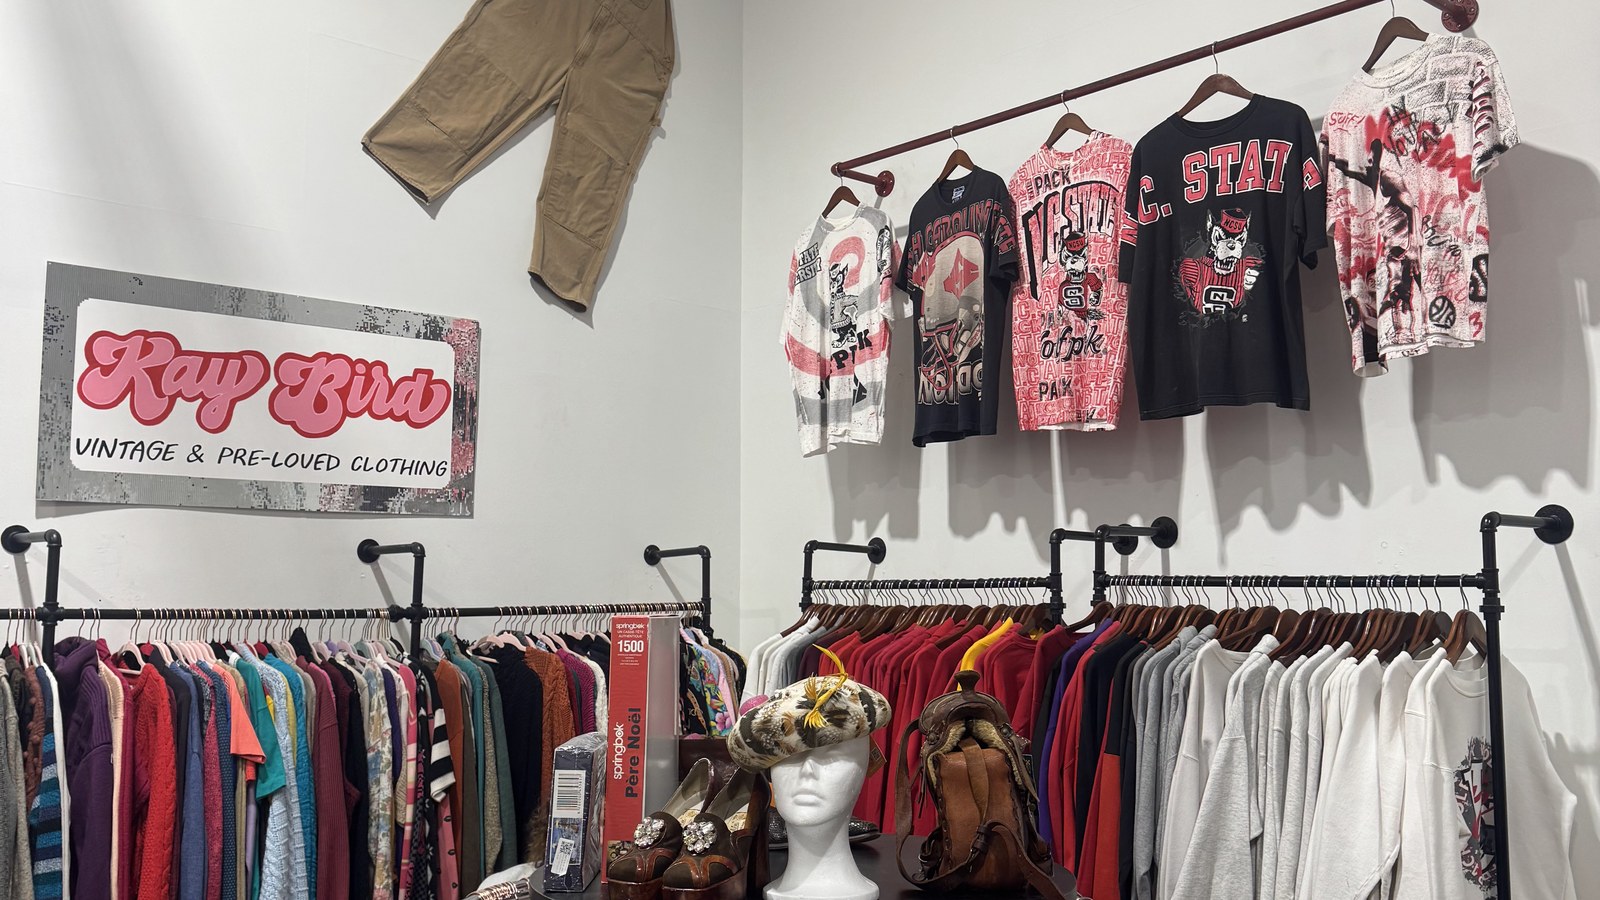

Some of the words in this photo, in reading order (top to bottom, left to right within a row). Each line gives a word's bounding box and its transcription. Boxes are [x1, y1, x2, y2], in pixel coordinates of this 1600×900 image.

[268, 351, 452, 439] Bird
[75, 437, 179, 463] VINTAGE
[186, 444, 205, 463] &
[217, 446, 341, 472] PRE-LOVED
[351, 456, 448, 477] CLOTHING
[617, 639, 645, 653] 1500
[627, 707, 641, 750] Noël
[612, 723, 626, 780] springbok
[625, 755, 640, 798] Père
